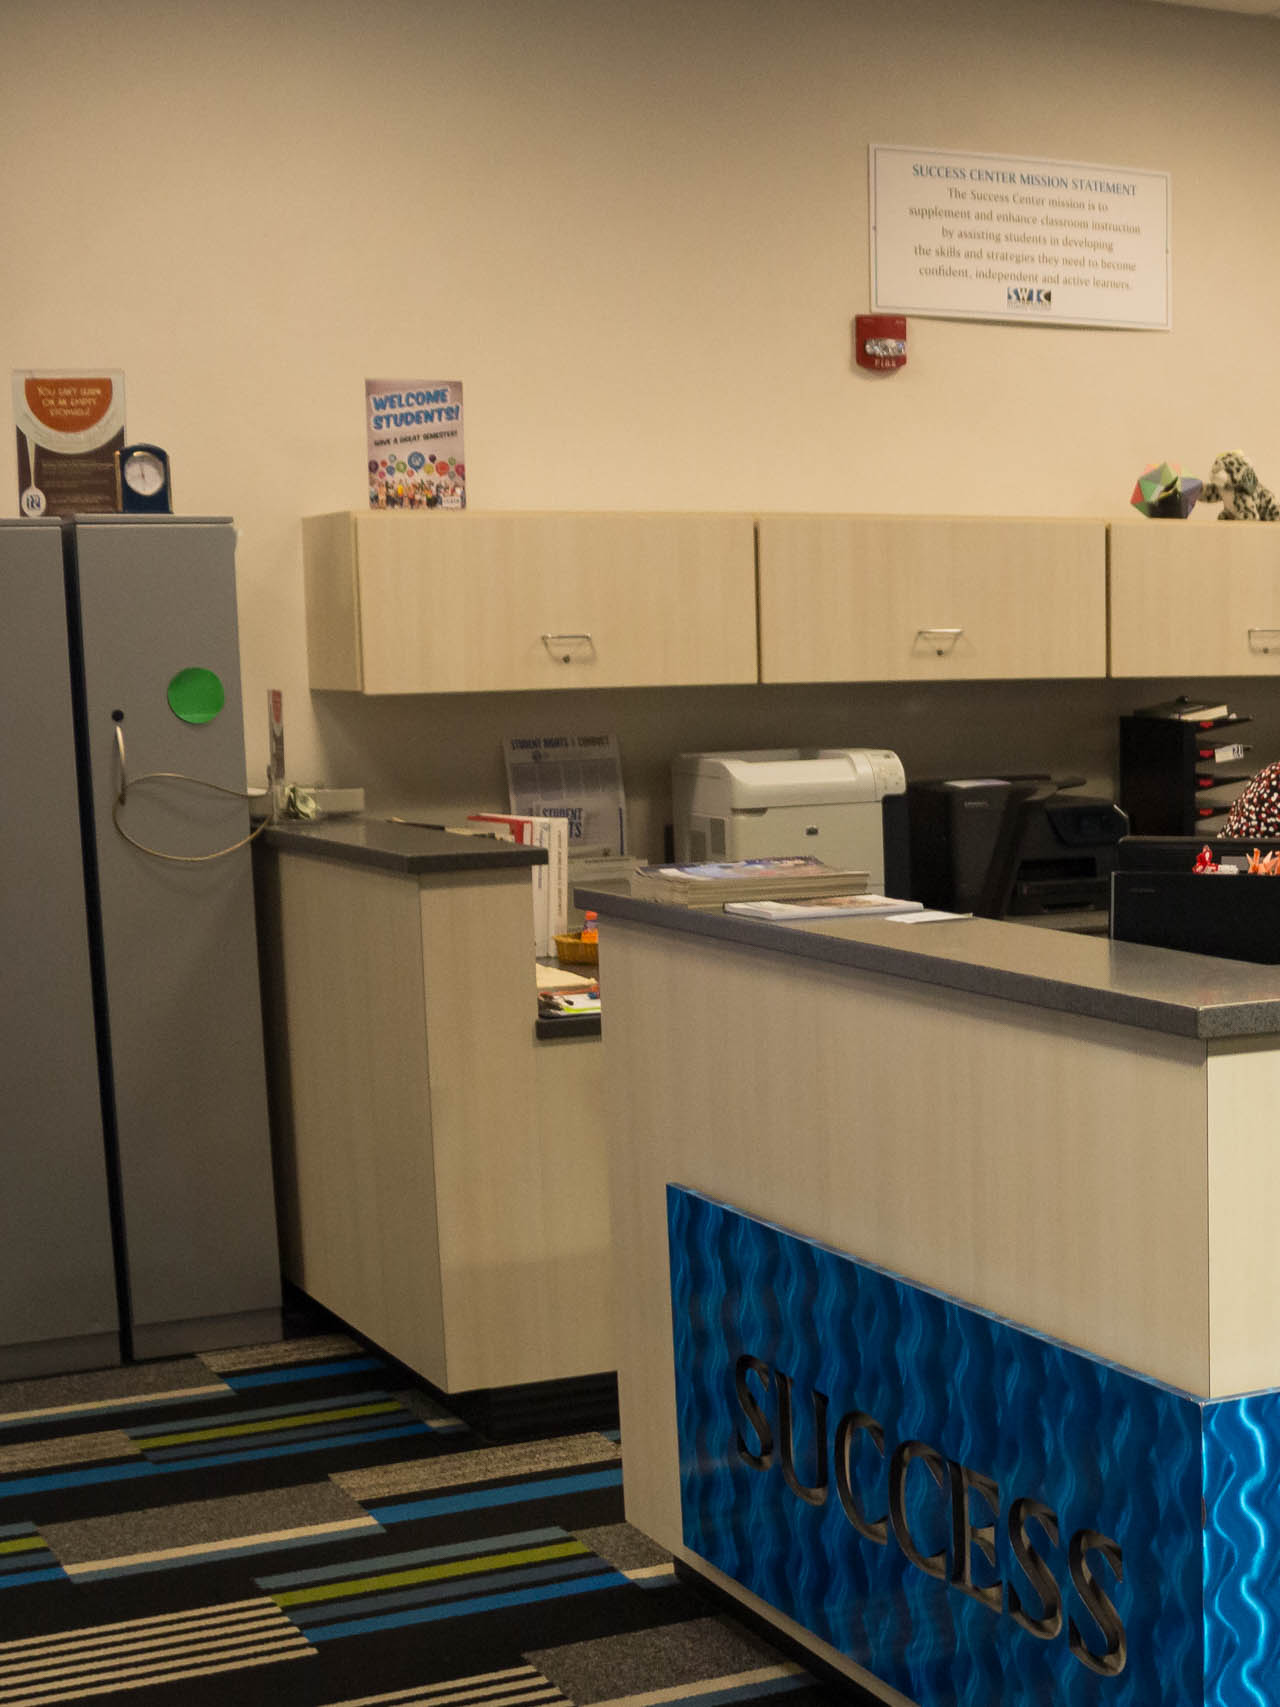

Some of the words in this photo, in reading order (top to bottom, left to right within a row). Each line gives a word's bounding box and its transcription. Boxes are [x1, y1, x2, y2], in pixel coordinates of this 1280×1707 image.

[912, 163, 966, 179] SUCCESS
[969, 168, 1017, 184] CENTER
[1020, 173, 1068, 189] MISSION
[1072, 178, 1137, 196] STATEMENT
[947, 187, 967, 200] The
[970, 190, 1009, 203] Success
[1012, 192, 1045, 207] Center
[1048, 196, 1085, 209] mission
[1087, 199, 1096, 211] is
[1098, 202, 1108, 212] to
[908, 206, 970, 219] supplement
[974, 209, 993, 221] and
[996, 211, 1037, 224] enhance
[1040, 214, 1088, 229] classroom
[1092, 219, 1140, 234] instruction
[941, 223, 953, 239] by
[957, 228, 1001, 243] assisting
[1004, 230, 1047, 245] students
[1050, 233, 1059, 246] in
[1061, 233, 1113, 252] developing
[914, 243, 932, 256] the
[934, 245, 961, 257] skills
[964, 247, 983, 259] and
[986, 249, 1035, 264] strategies
[1038, 252, 1061, 267] they
[1062, 256, 1085, 268] need
[1088, 257, 1098, 269] to
[1101, 259, 1136, 272] become
[919, 264, 972, 278] confident,
[975, 267, 1039, 283] independent
[1041, 273, 1059, 285] and
[1062, 274, 1090, 288] active
[1092, 276, 1132, 291] learners.
[372, 389, 448, 411] WELCOME
[373, 405, 459, 430] STUDENTS!
[735, 1355, 1126, 1677] SUCCESS
